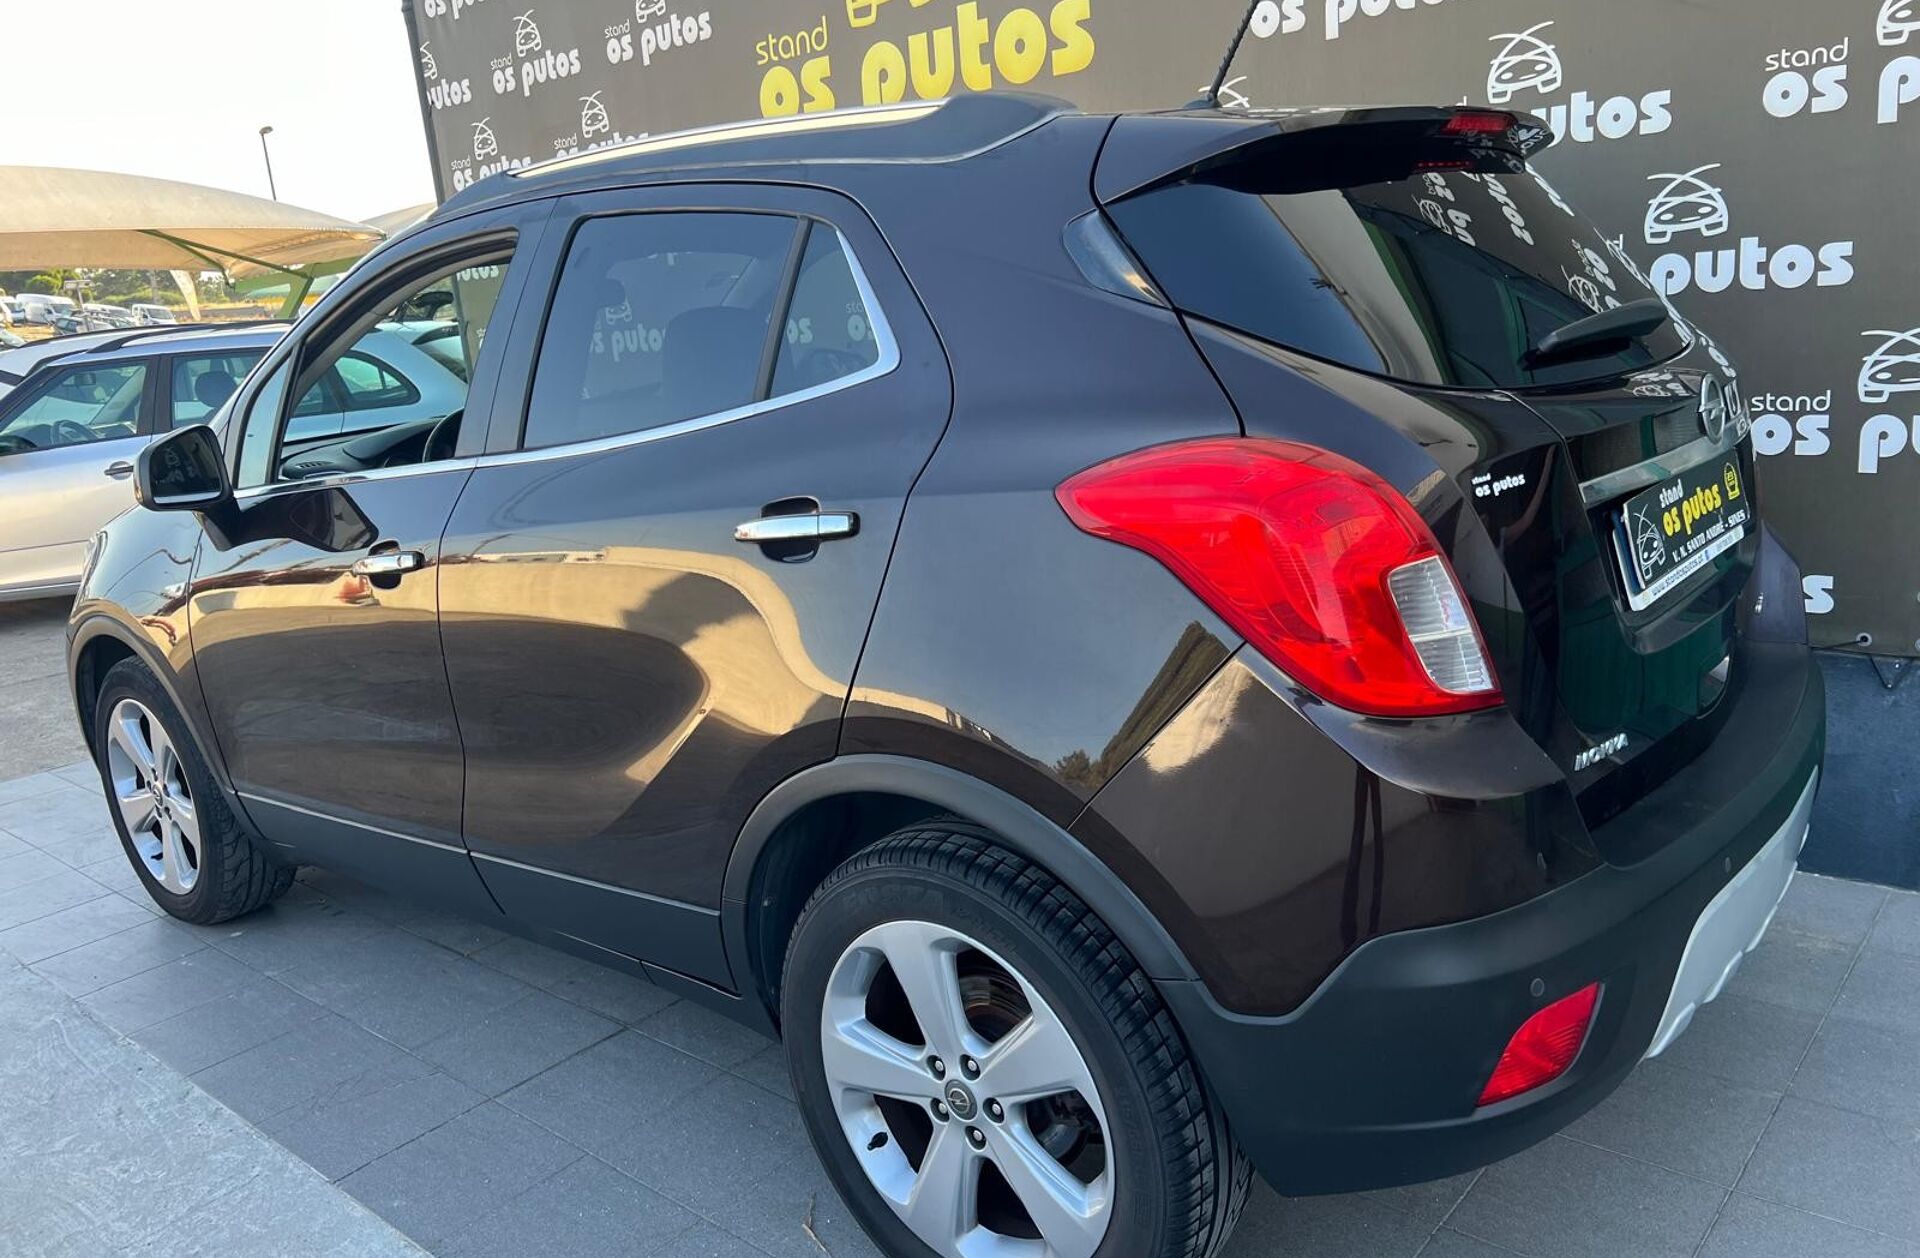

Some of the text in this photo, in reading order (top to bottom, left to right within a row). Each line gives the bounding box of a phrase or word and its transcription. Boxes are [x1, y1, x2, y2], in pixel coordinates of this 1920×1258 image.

[604, 19, 630, 39] stand
[606, 10, 713, 66] os putos
[1251, 0, 1306, 38] os
[756, 15, 828, 65] stand
[759, 0, 1095, 118] os putos
[1765, 37, 1849, 71] stand
[490, 53, 513, 71] stand
[493, 48, 581, 97] os putos
[427, 78, 472, 109] utos
[1762, 64, 1848, 118] os
[1530, 90, 1672, 149] utos
[553, 135, 577, 149] stand
[1649, 236, 1855, 300] putos
[612, 322, 666, 361] puto
[1751, 390, 1831, 412] stand
[1751, 414, 1831, 456] os
[1475, 473, 1526, 498] os putos
[1659, 478, 1684, 509] stand
[1663, 484, 1722, 537] os putos
